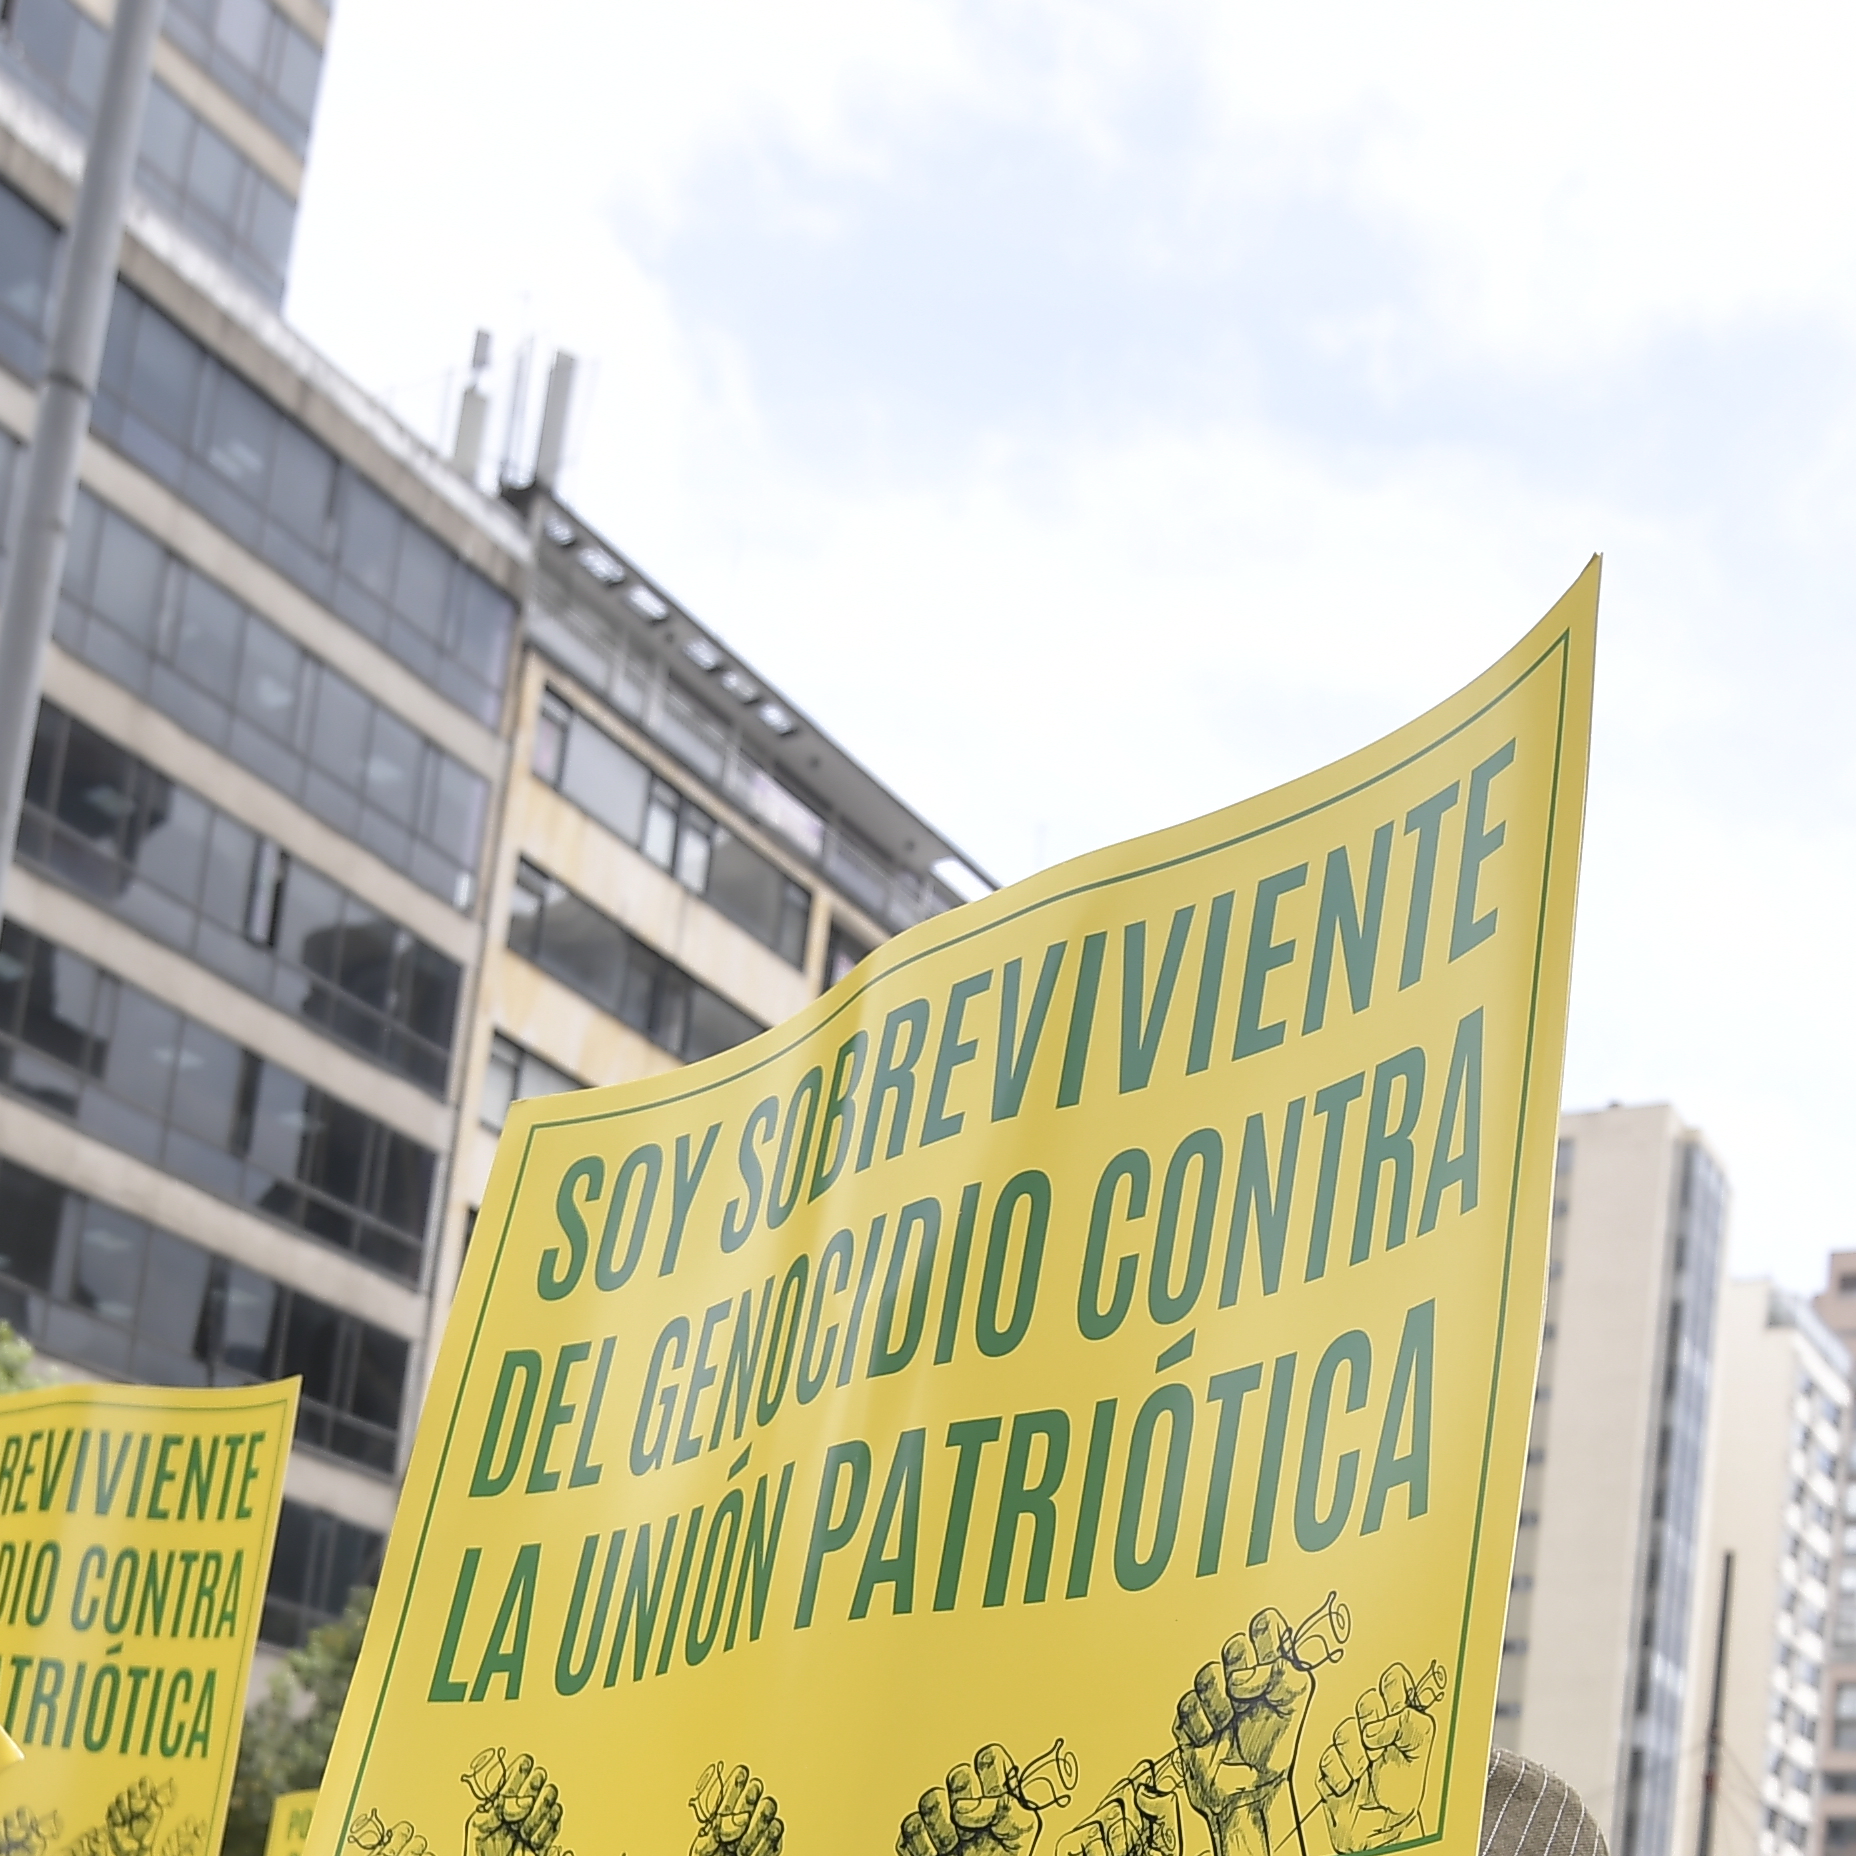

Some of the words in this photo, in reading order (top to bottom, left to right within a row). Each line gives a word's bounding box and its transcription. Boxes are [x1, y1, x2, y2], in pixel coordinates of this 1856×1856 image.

[537, 1123, 722, 1300] SOY
[721, 738, 1517, 1251] SOBREVIVIENTE
[468, 1333, 603, 1499] DEL
[630, 1170, 1053, 1472] GENOCIDIO
[1077, 1007, 1485, 1340] CONTRA
[70, 1544, 245, 1639] CONTRA
[428, 1544, 537, 1703] LA
[552, 1443, 795, 1695] UNIÓN
[795, 1298, 1435, 1631] PATRIÓTICA
